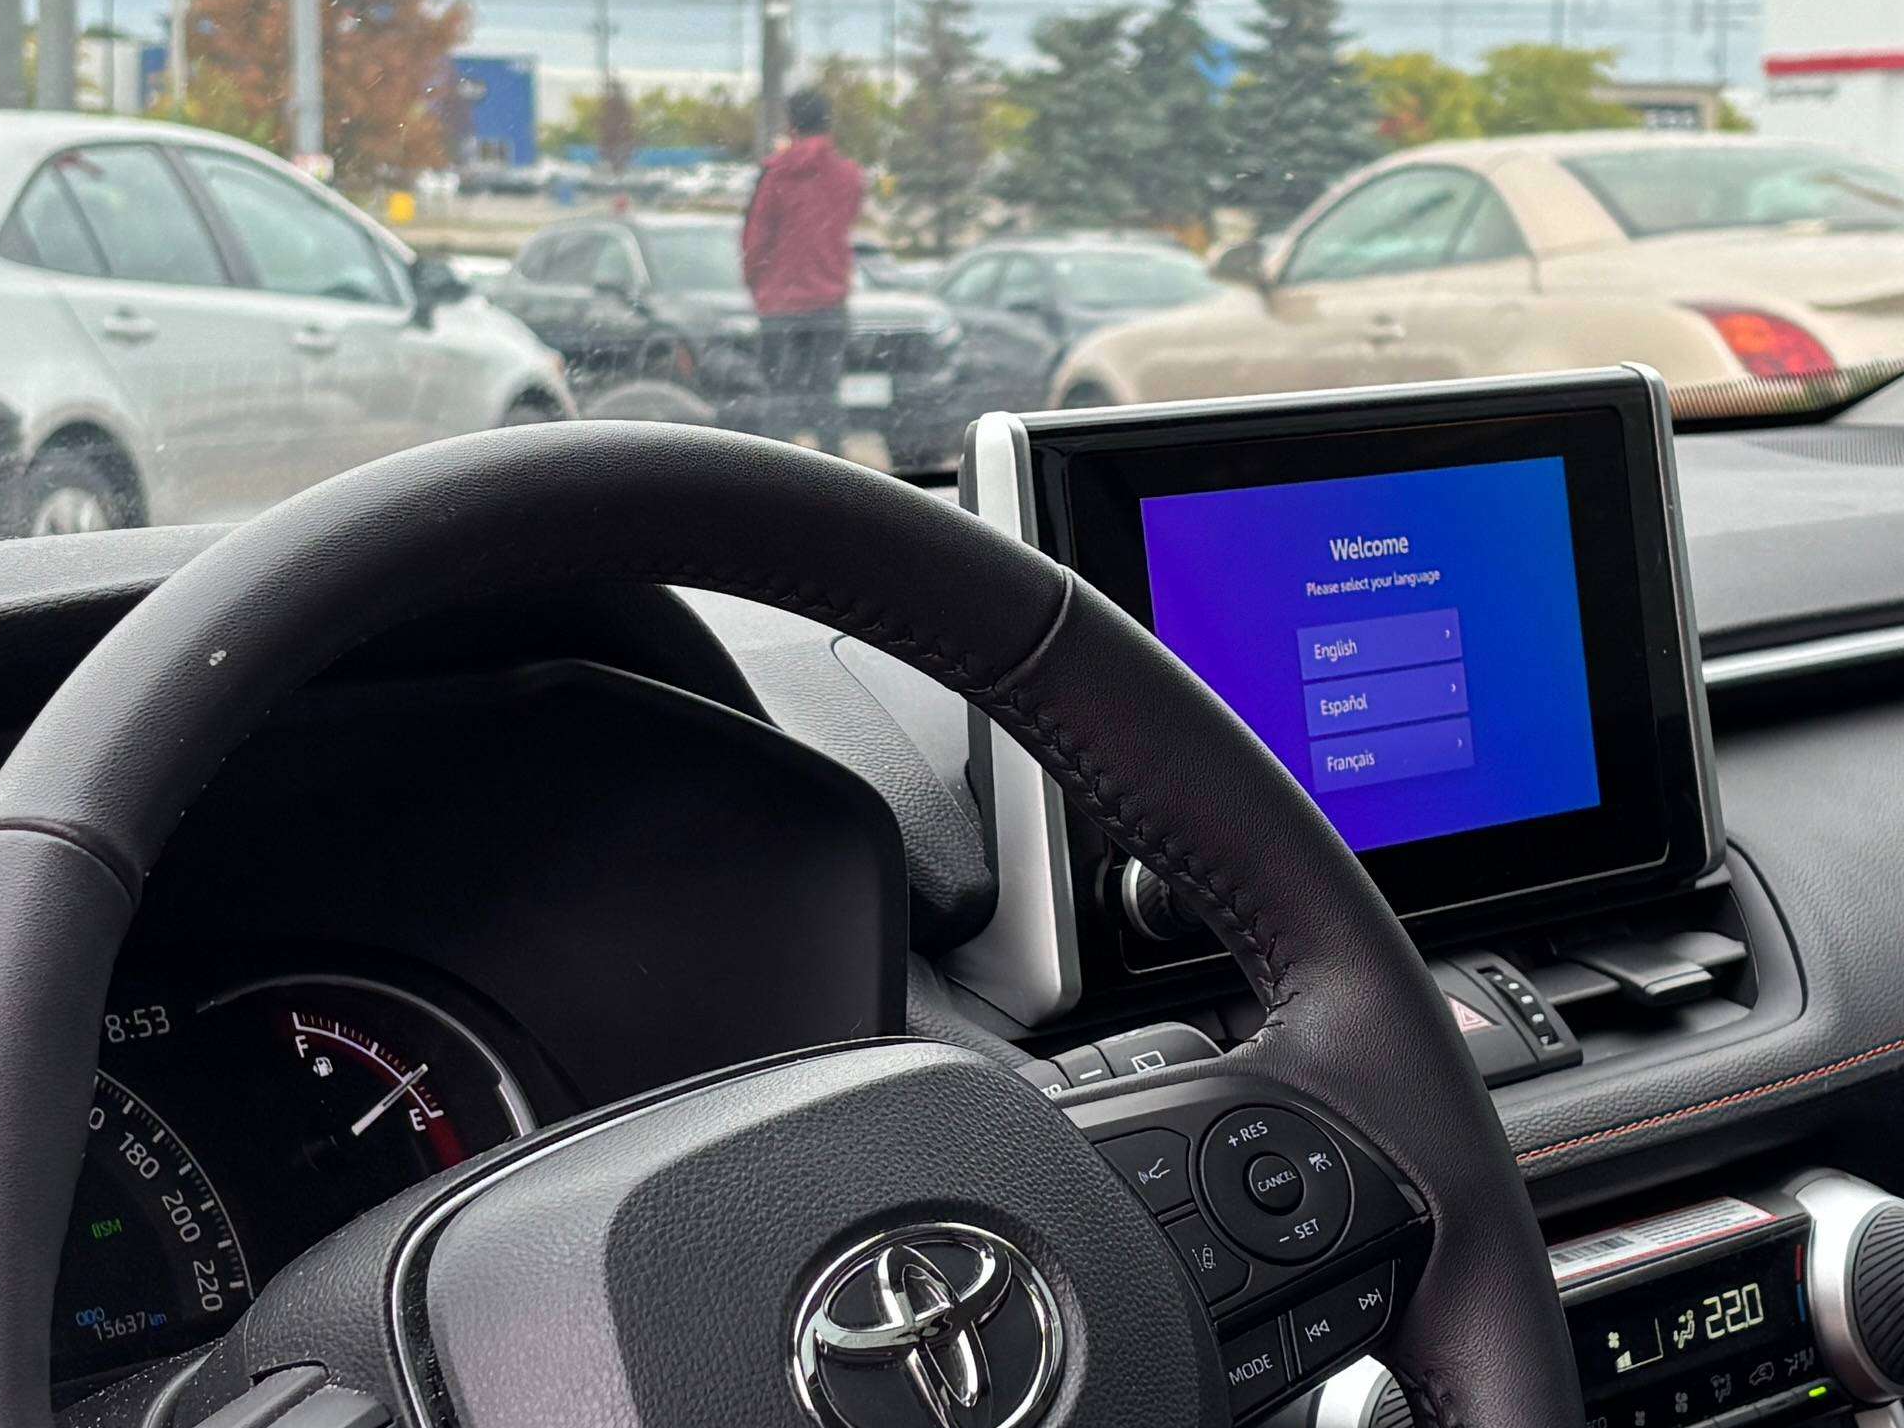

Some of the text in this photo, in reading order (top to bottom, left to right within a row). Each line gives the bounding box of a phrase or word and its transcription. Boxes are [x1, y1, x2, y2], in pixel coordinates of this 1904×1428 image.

[1329, 535, 1410, 561] Welcome
[1306, 569, 1441, 597] Please select your language
[1314, 639, 1358, 662] English
[1320, 693, 1368, 717] Español
[1327, 750, 1376, 773] Français
[104, 1005, 171, 1043] 8:53
[295, 1035, 309, 1059] F
[409, 1108, 427, 1131] E
[1239, 1119, 1269, 1141] RES
[118, 1131, 160, 1179] 180
[1257, 1168, 1297, 1194] CANCEL
[161, 1189, 201, 1243] 200
[1294, 1218, 1322, 1240] SET
[193, 1259, 223, 1312] 220
[94, 1311, 146, 1341] 15637
[1227, 1352, 1274, 1387] MODE
